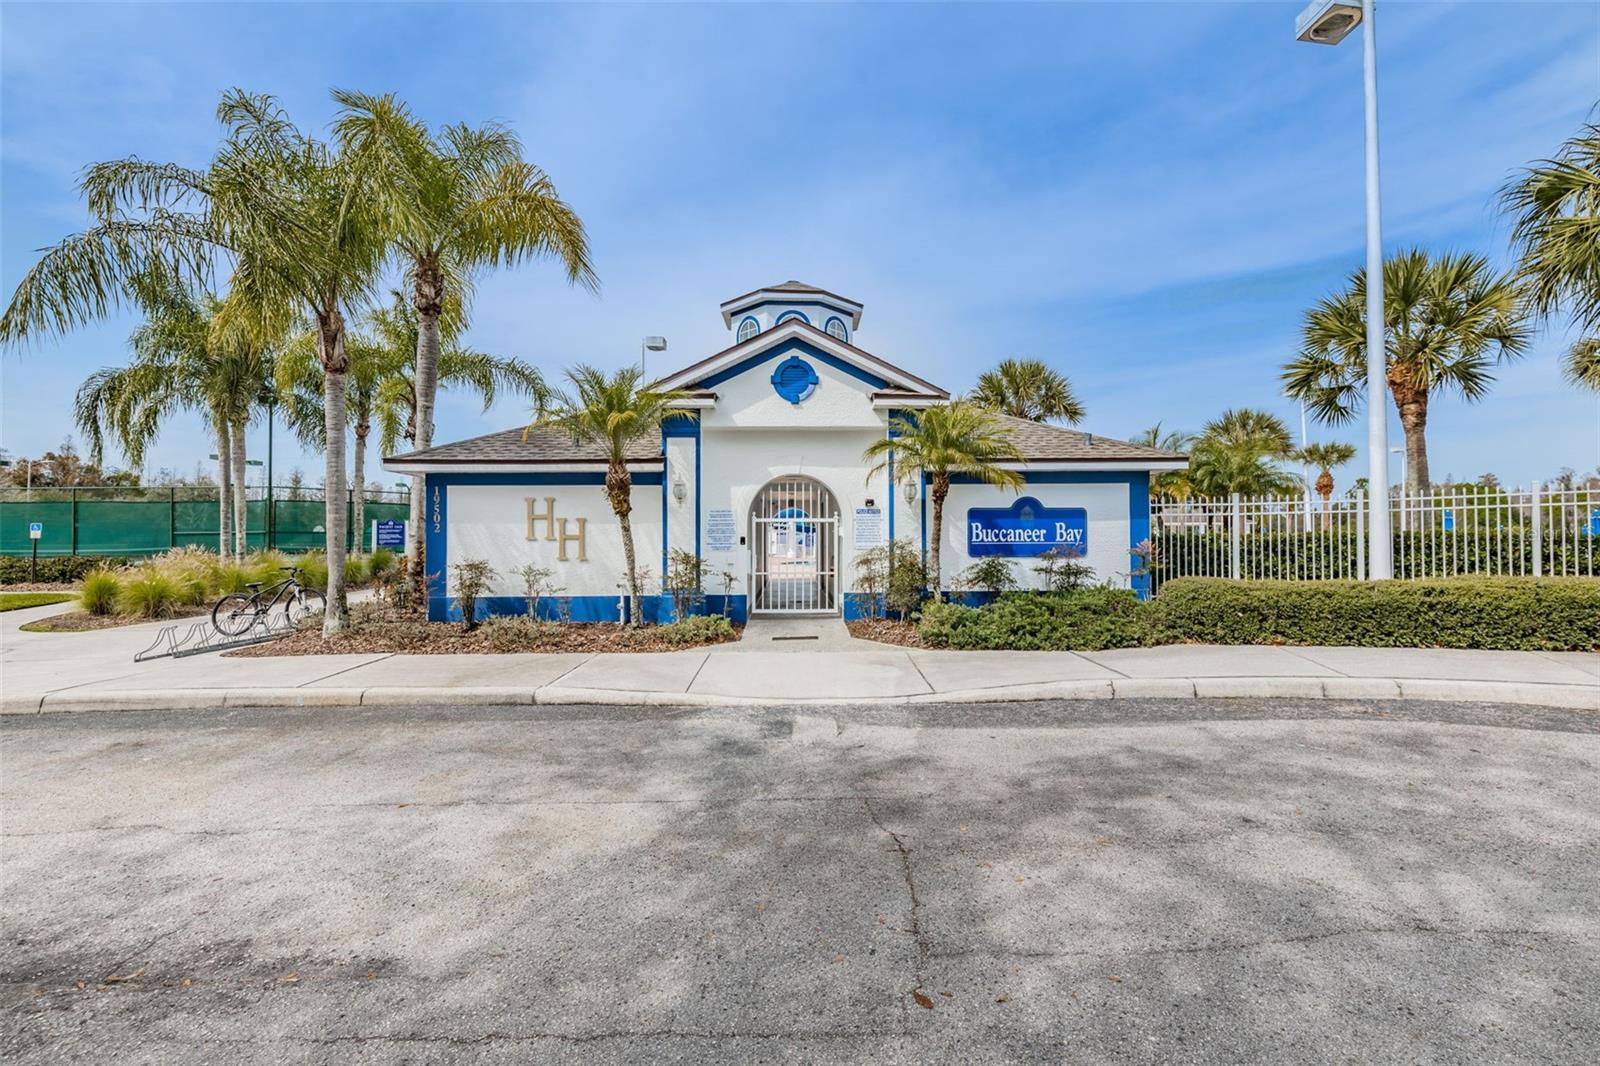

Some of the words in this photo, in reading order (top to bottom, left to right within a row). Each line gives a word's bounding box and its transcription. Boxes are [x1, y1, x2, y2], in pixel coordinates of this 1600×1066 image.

[433, 486, 441, 534] 19502
[971, 522, 1046, 542] Buccaneer
[1055, 522, 1083, 546] Bay
